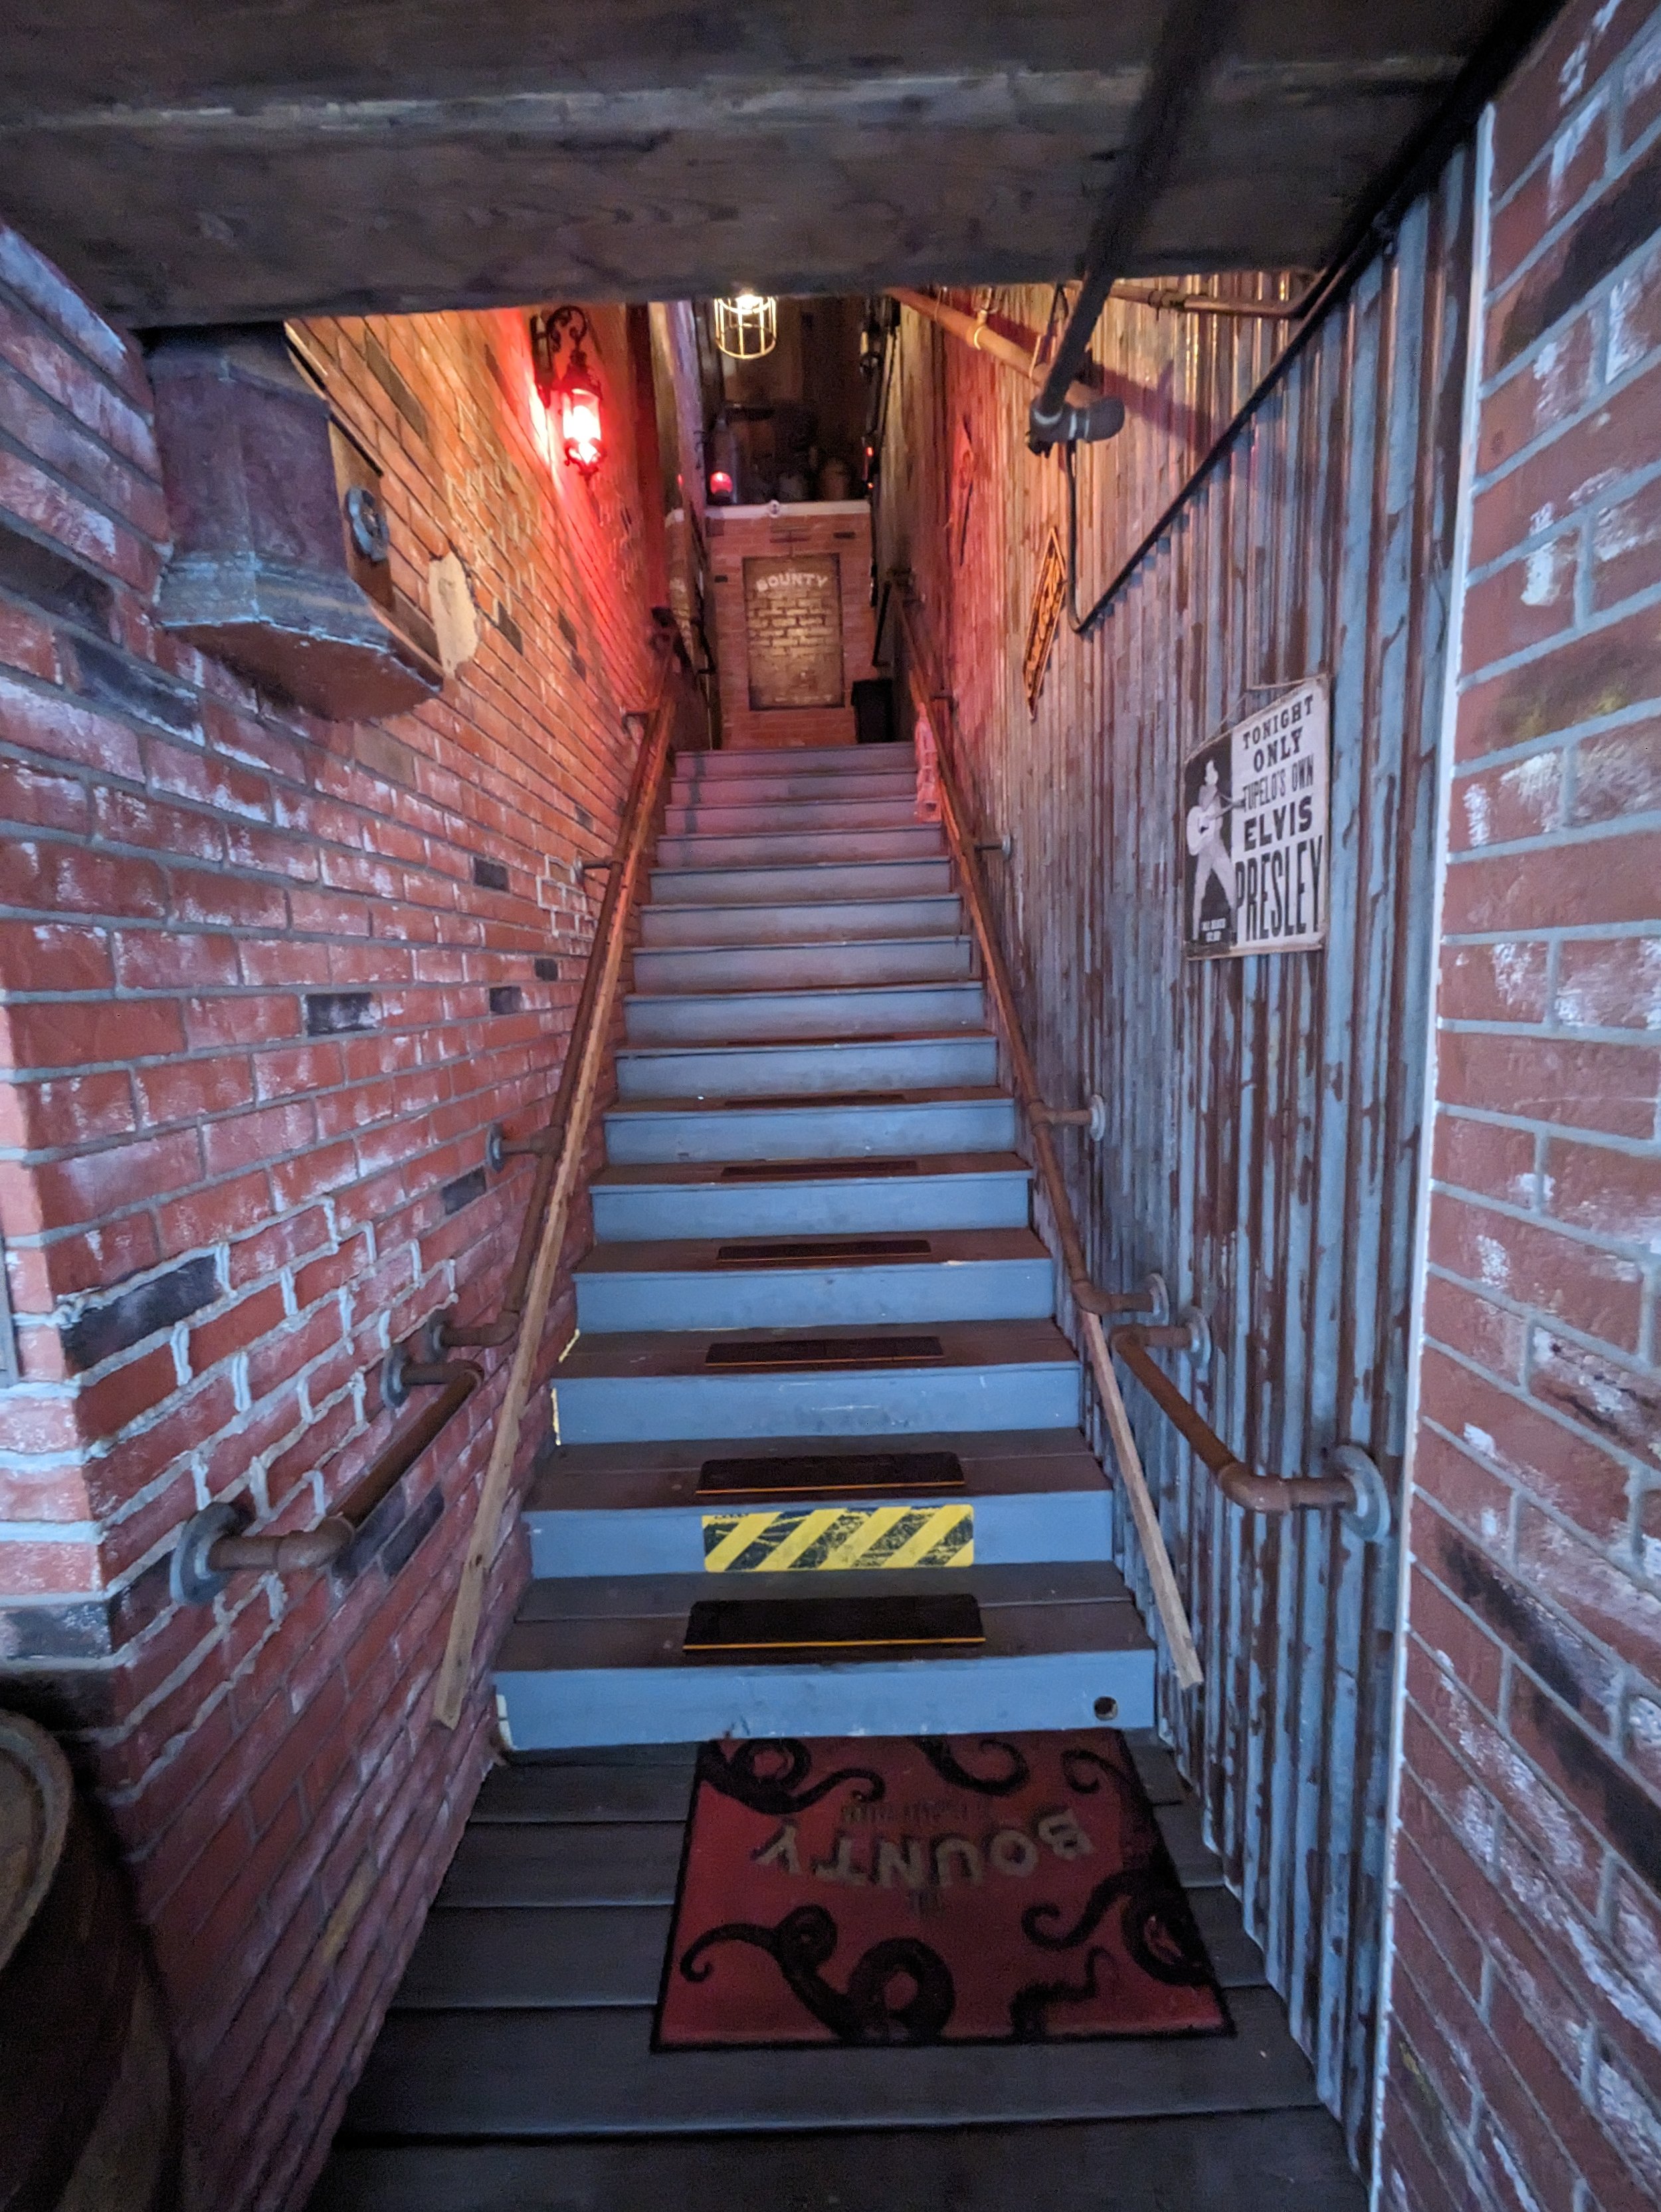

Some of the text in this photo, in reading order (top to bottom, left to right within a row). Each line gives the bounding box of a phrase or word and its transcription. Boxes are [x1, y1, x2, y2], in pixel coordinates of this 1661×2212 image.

[1242, 695, 1314, 750] TONIGHT
[1254, 727, 1303, 773] ONLY
[1291, 754, 1315, 789] OWN
[1244, 795, 1314, 852] ELVIS
[1234, 835, 1323, 942] PRESLEY
[751, 1807, 1095, 1888] BOUNTY
